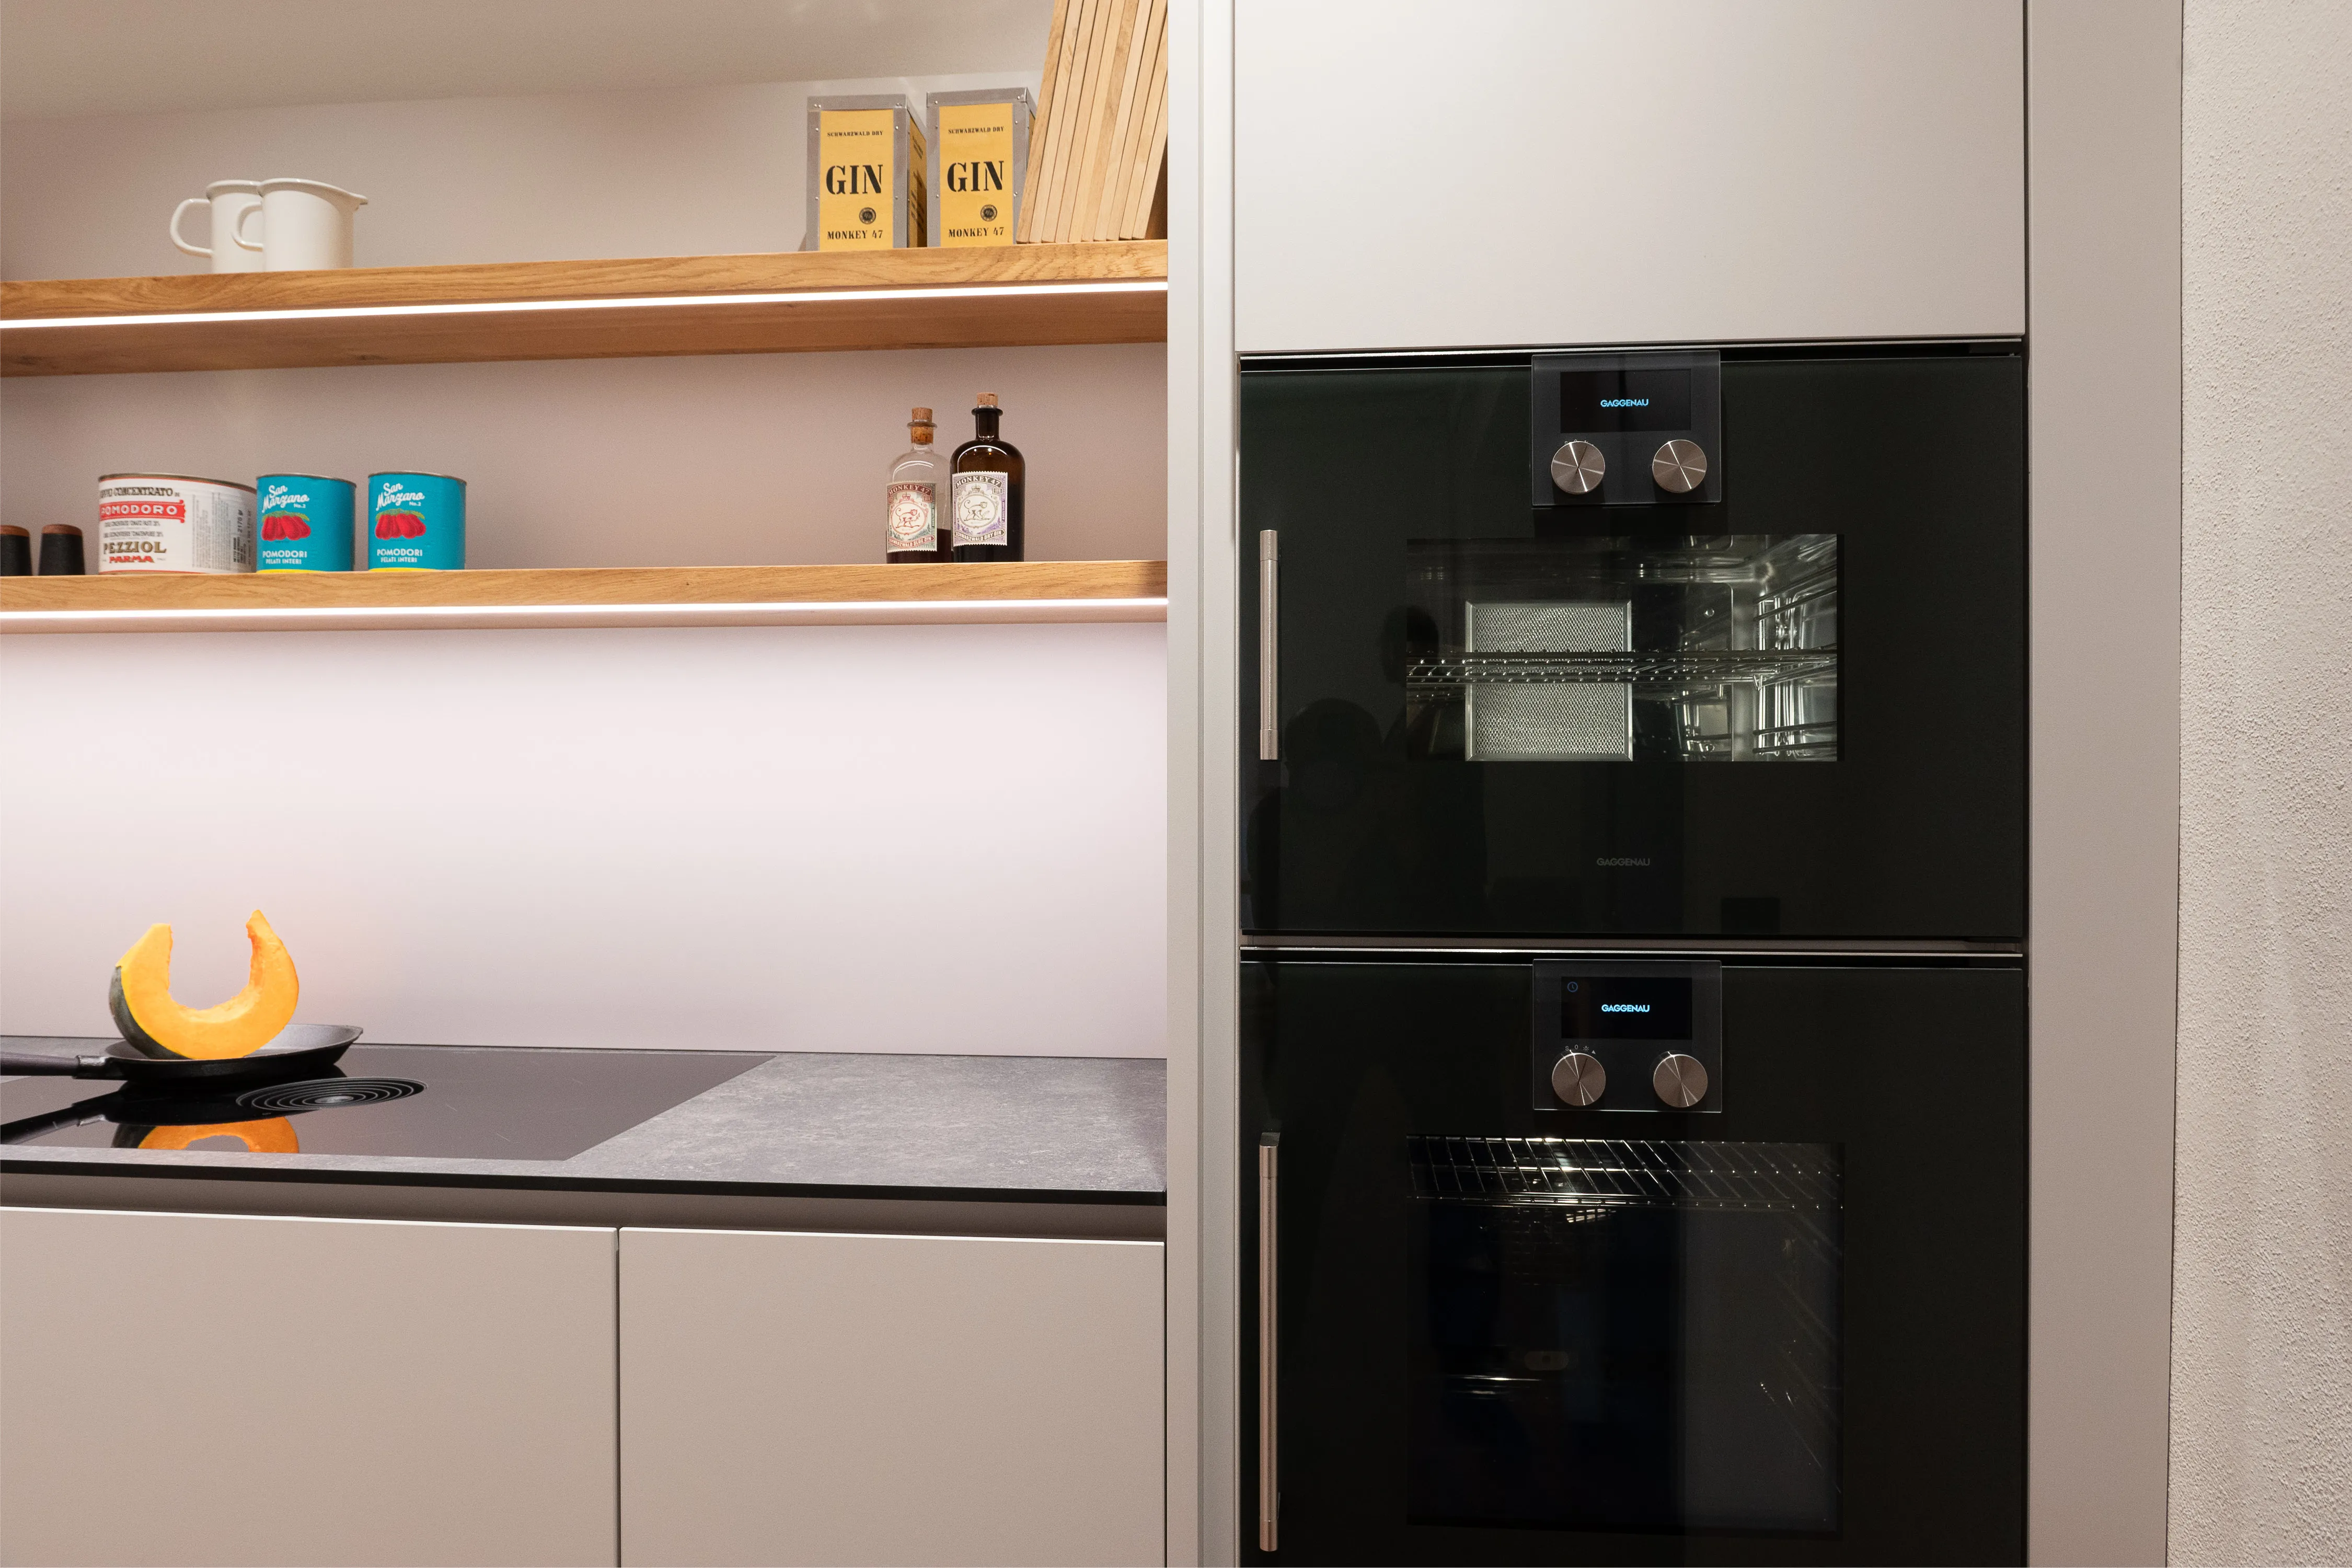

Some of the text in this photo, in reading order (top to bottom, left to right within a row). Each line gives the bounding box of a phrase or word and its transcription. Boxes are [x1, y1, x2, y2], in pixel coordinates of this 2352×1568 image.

[826, 164, 883, 195] GIN
[947, 160, 1004, 192] GIN
[827, 229, 883, 240] MONKEY 47
[949, 227, 1004, 237] MONKEY 47
[1600, 399, 1649, 407] GAGGENAU
[956, 476, 990, 488] MONKEY
[113, 487, 173, 497] CONCENTRATO
[269, 485, 288, 498] San
[383, 482, 403, 496] San
[889, 485, 919, 495] MONKEY
[262, 494, 310, 513] Marzano
[375, 492, 425, 511] Marzano
[955, 531, 983, 541] SCHWARZWALD
[103, 540, 167, 555] PEZZIOL
[889, 538, 913, 547] SCHWARZWALD
[262, 550, 307, 558] POMODORI
[377, 548, 423, 557] POMODORI
[109, 555, 155, 563] PARMA
[1596, 858, 1651, 866] GAGGENAU
[1601, 1004, 1650, 1012] GAGGENAU
